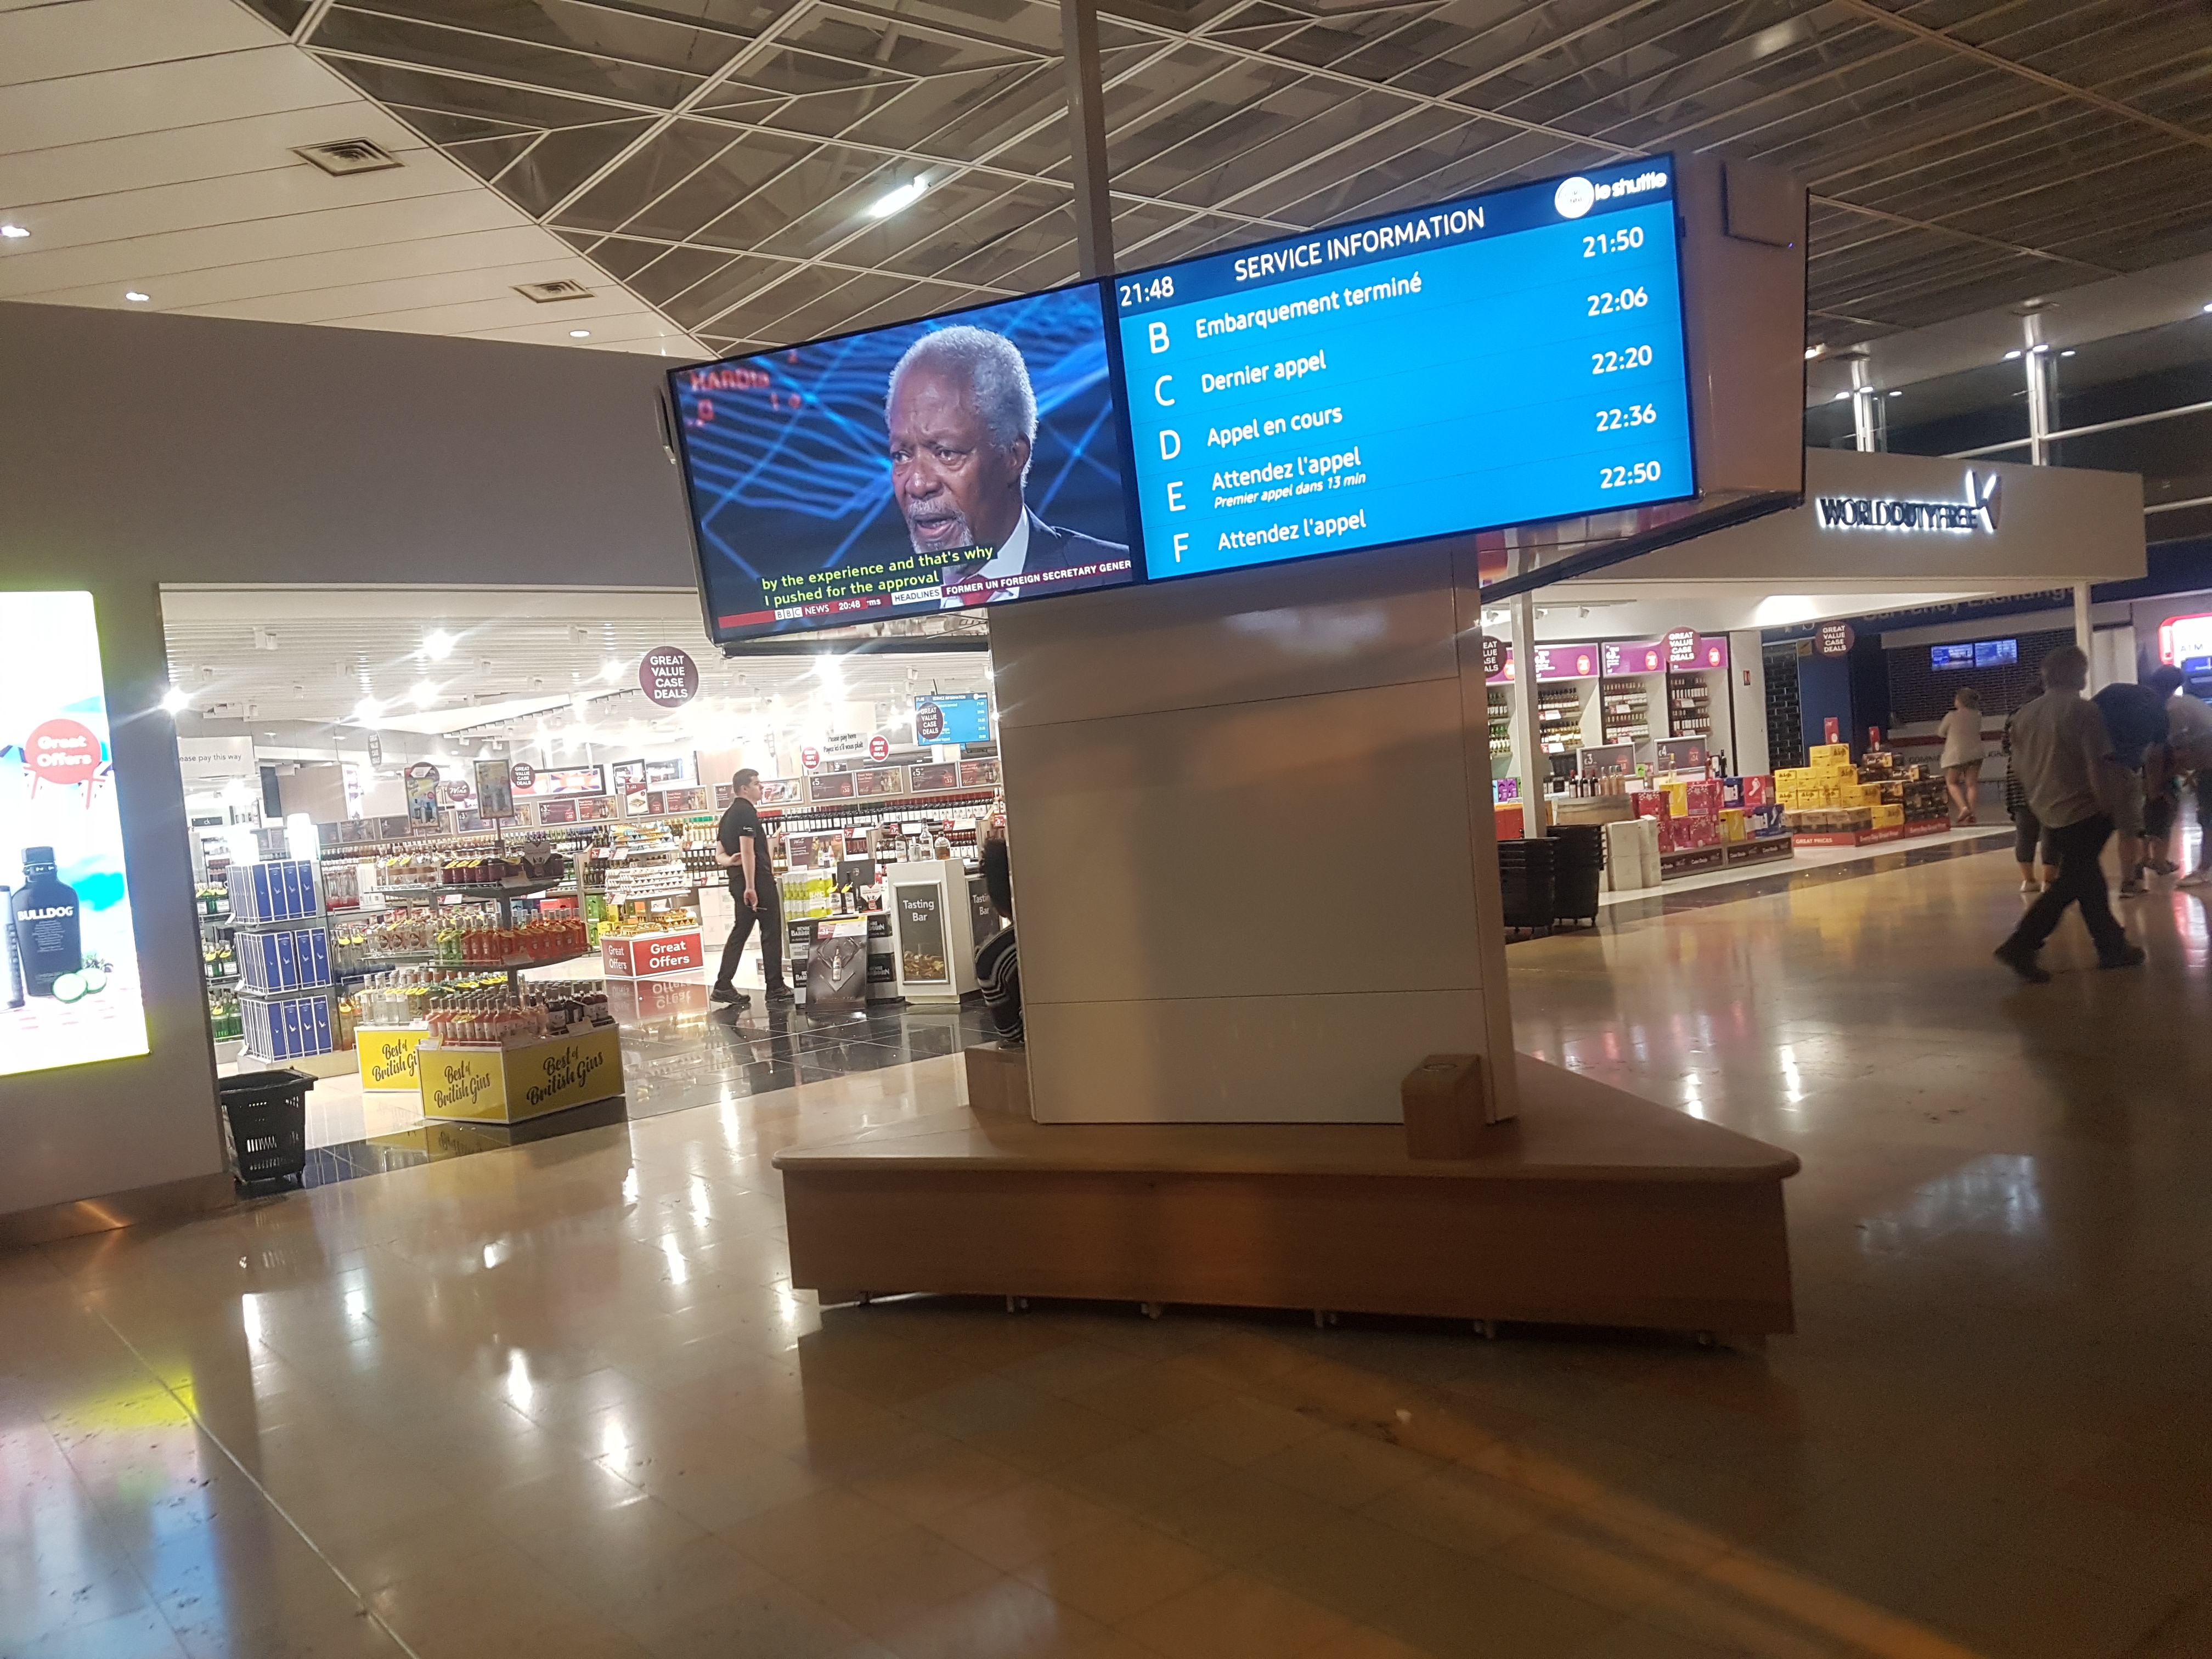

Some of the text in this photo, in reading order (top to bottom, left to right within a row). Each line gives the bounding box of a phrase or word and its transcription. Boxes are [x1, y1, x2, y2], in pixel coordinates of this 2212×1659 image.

[1594, 183, 1611, 201] le
[1234, 207, 1485, 281] SERVICE INFORMATION
[1583, 227, 1644, 258] 21:50
[1120, 276, 1174, 306] 21:48
[1587, 286, 1647, 317] 22:06
[1148, 272, 1422, 354] B Embarquement terminé
[1592, 345, 1652, 374] 22:20
[1155, 349, 1326, 406] C Dernier appel
[1596, 403, 1657, 432] 22:36
[1159, 407, 1343, 460] D Appel en cours
[1167, 446, 1361, 511] E Attendez l'appel
[1600, 460, 1661, 489] 22:50
[1214, 472, 1367, 509] Premier appel dans 13 min
[1173, 509, 1367, 562] F Attendez l'appel
[761, 546, 994, 591] by the experience and that's why
[946, 560, 1131, 596] FORMER UN FOREIGN SECRETARY GENER
[764, 571, 939, 608] I pushed for the approval
[894, 589, 940, 603] HEADLINES
[775, 604, 830, 620] BBC NEWS
[838, 600, 861, 611] 20:48
[1669, 631, 1694, 641] GREAT
[1669, 639, 1694, 647] VALUE
[1483, 641, 1498, 649] EAT
[1824, 645, 1847, 653] DEALS
[650, 655, 684, 665] GREAT
[1670, 653, 1694, 662] DEALS
[651, 667, 685, 676] VALUE
[655, 678, 684, 687] CASE
[654, 689, 688, 699] DEALS
[923, 727, 939, 735] DEALS
[38, 735, 87, 749] Great
[37, 752, 92, 767] Offers
[449, 785, 466, 794] Wine
[902, 899, 935, 910] Tasting
[972, 894, 989, 904] Tasti
[17, 906, 74, 921] BULLDOG
[912, 913, 928, 922] Bar
[979, 906, 990, 916] Bar
[608, 945, 624, 956] Great
[650, 940, 686, 955] Great
[609, 958, 627, 969] Offers
[650, 956, 690, 968] Offers
[382, 1039, 408, 1060] Best of
[372, 1051, 417, 1082] British Gi
[543, 1046, 579, 1076] Best of
[444, 1060, 471, 1084] Best of
[526, 1051, 603, 1105] British Gins
[434, 1072, 491, 1108] British Gins
